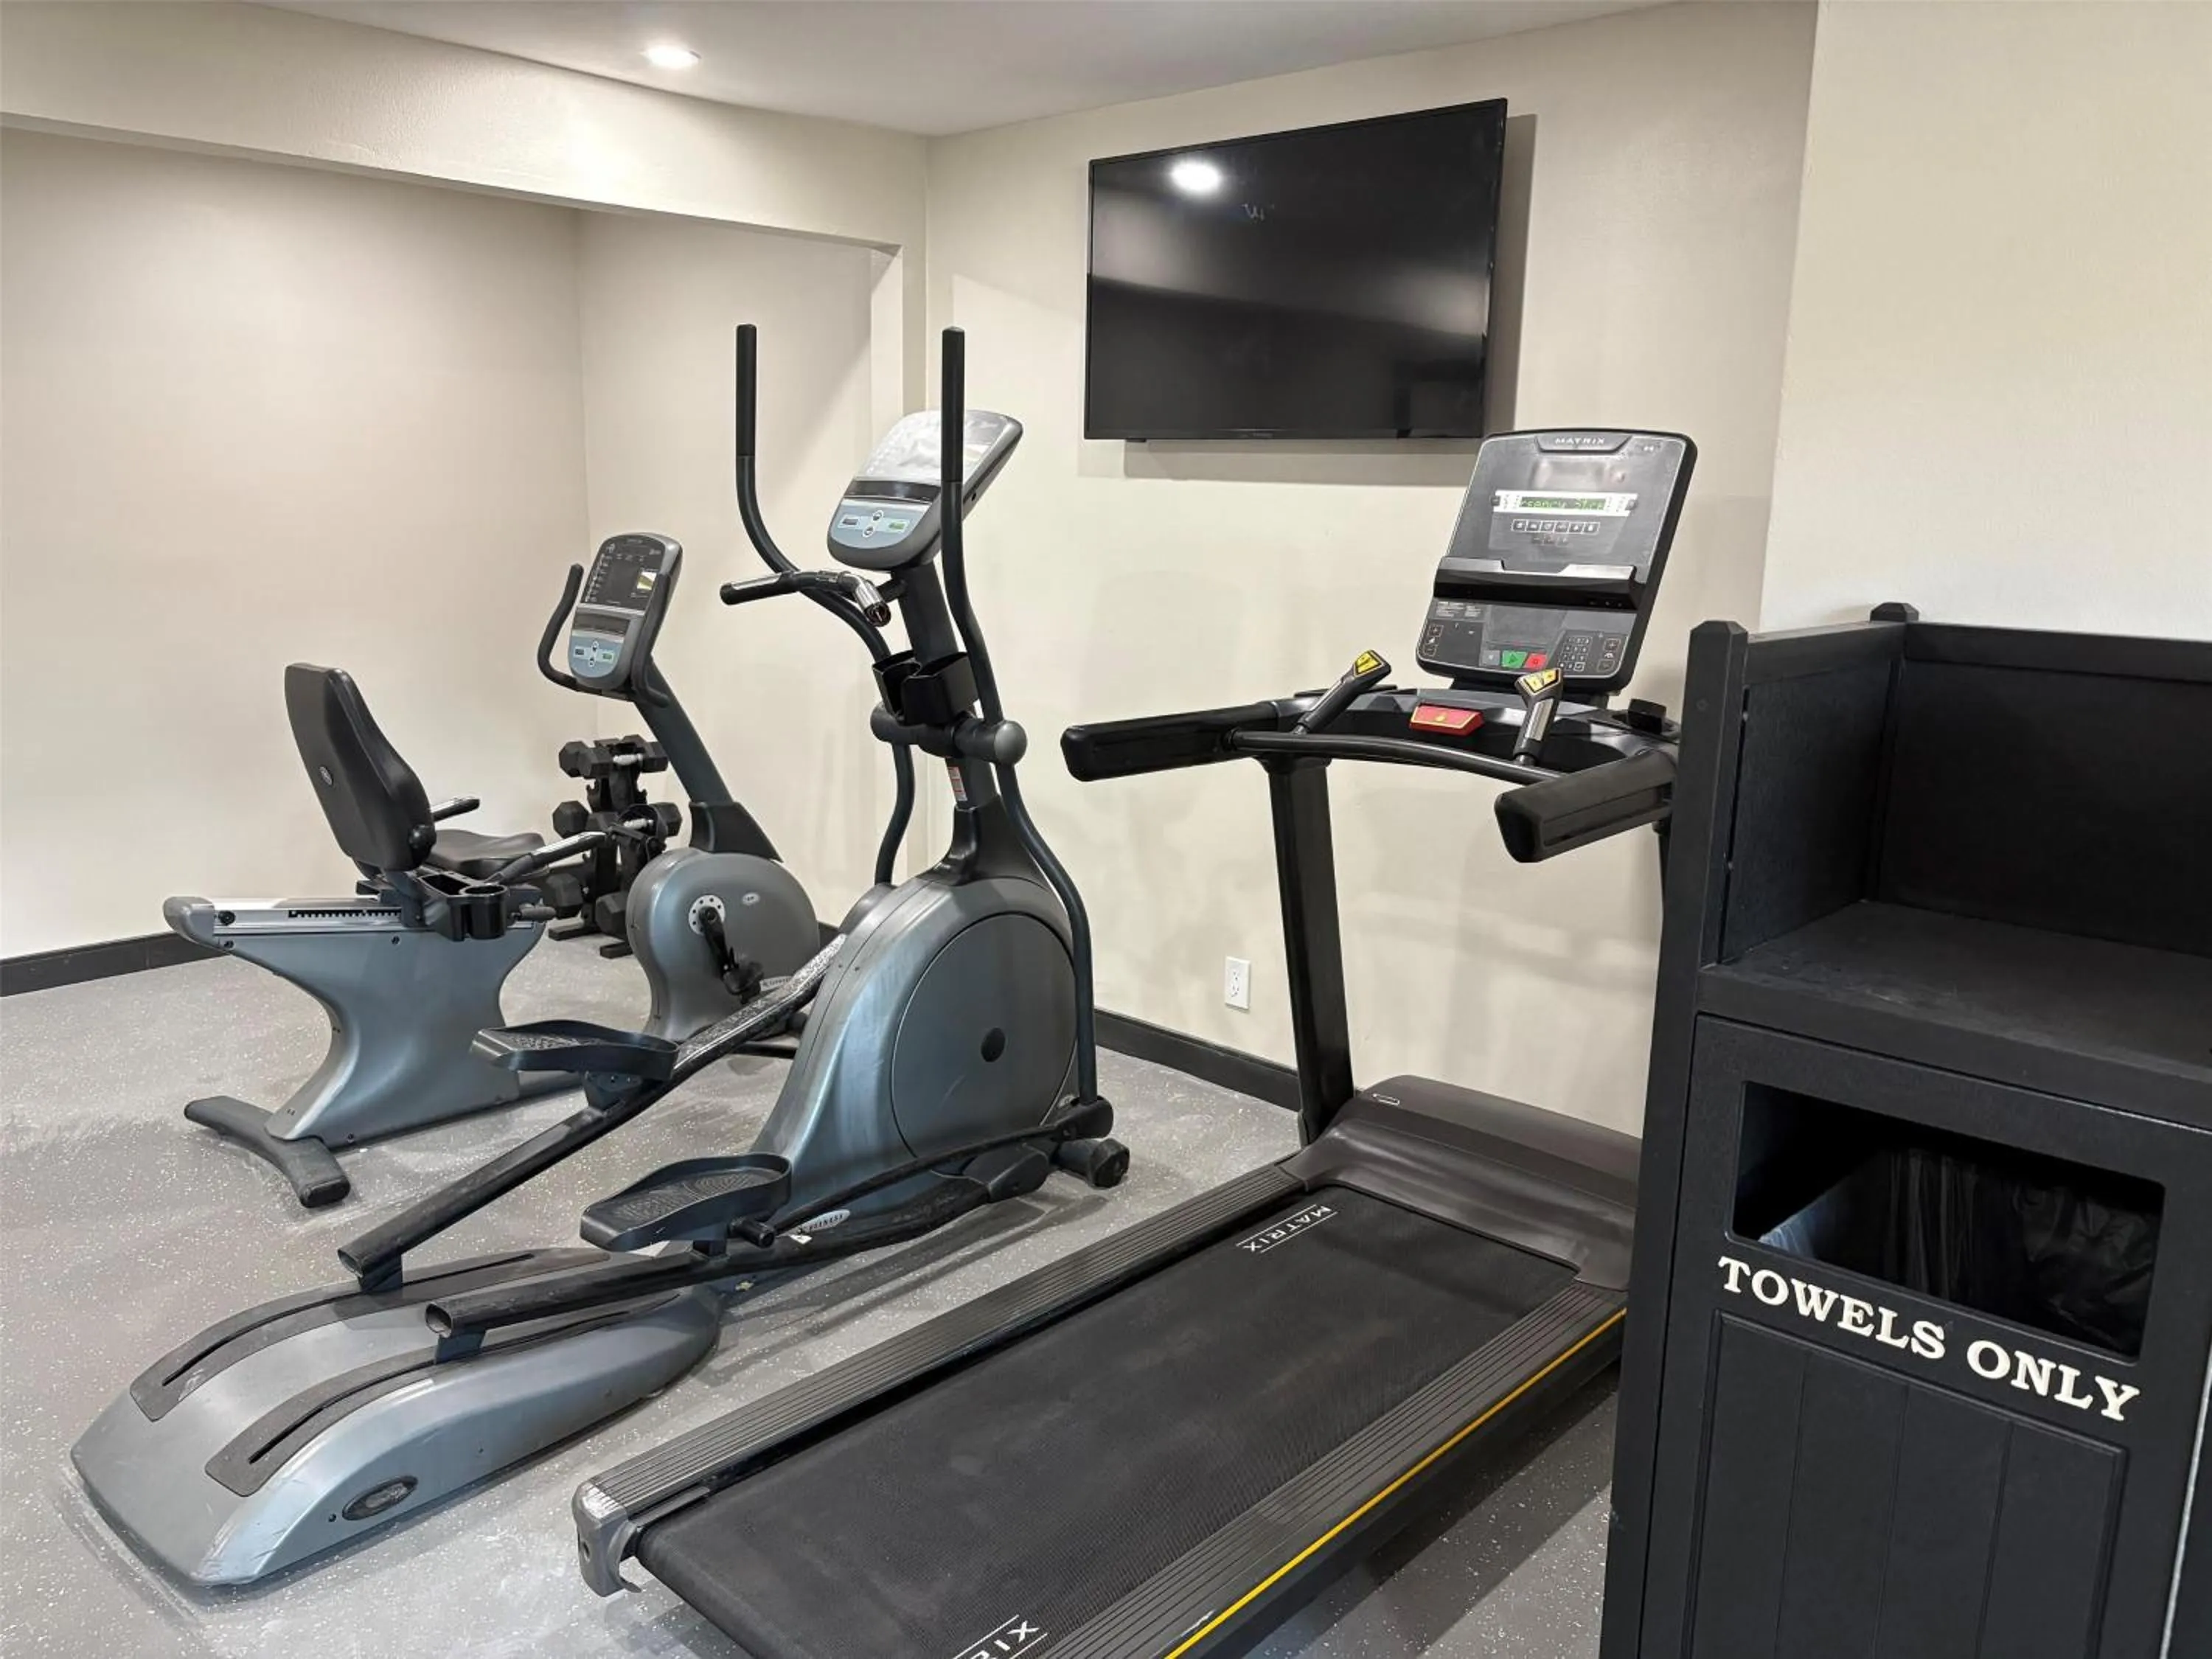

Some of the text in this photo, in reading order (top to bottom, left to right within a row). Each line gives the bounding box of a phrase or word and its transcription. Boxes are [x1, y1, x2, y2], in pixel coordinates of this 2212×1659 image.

[1555, 437, 1605, 445] MATRIX
[1243, 1206, 1332, 1252] MATRIX
[1718, 1256, 2140, 1421] TOWELS ONLY
